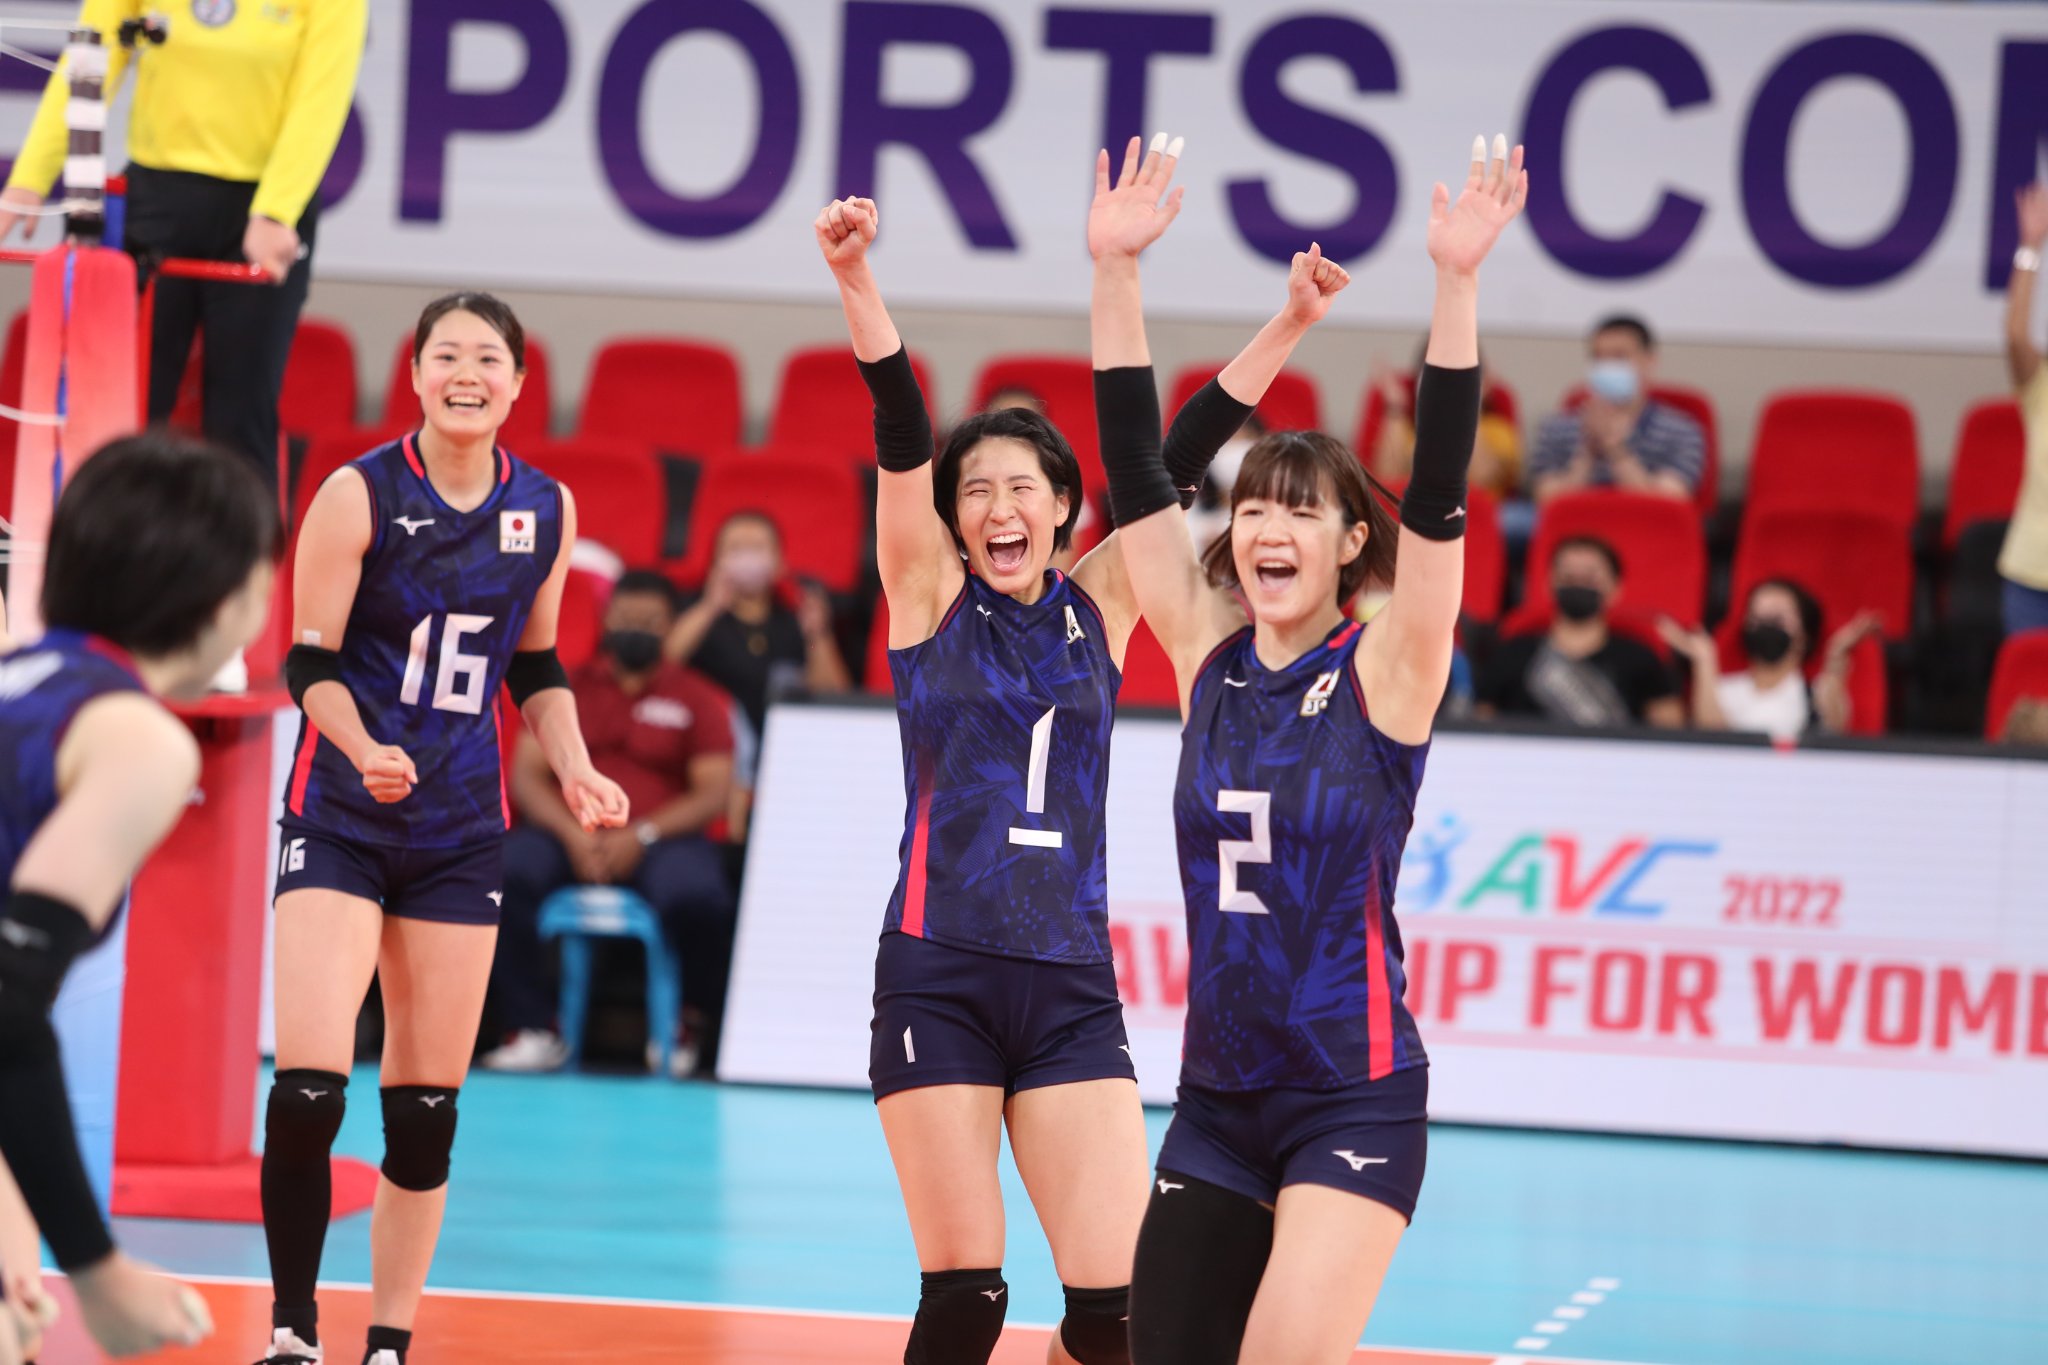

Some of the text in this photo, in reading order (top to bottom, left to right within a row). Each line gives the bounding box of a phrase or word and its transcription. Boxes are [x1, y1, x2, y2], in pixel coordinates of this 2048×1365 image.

[315, 0, 1402, 268] PORTS
[400, 613, 495, 715] 16
[1026, 705, 1056, 814] 1
[280, 837, 306, 876] 16
[1217, 790, 1271, 914] 2
[1457, 833, 1842, 927] AVC 2022
[1527, 945, 1720, 1039] FOR
[903, 1026, 916, 1063] 1
